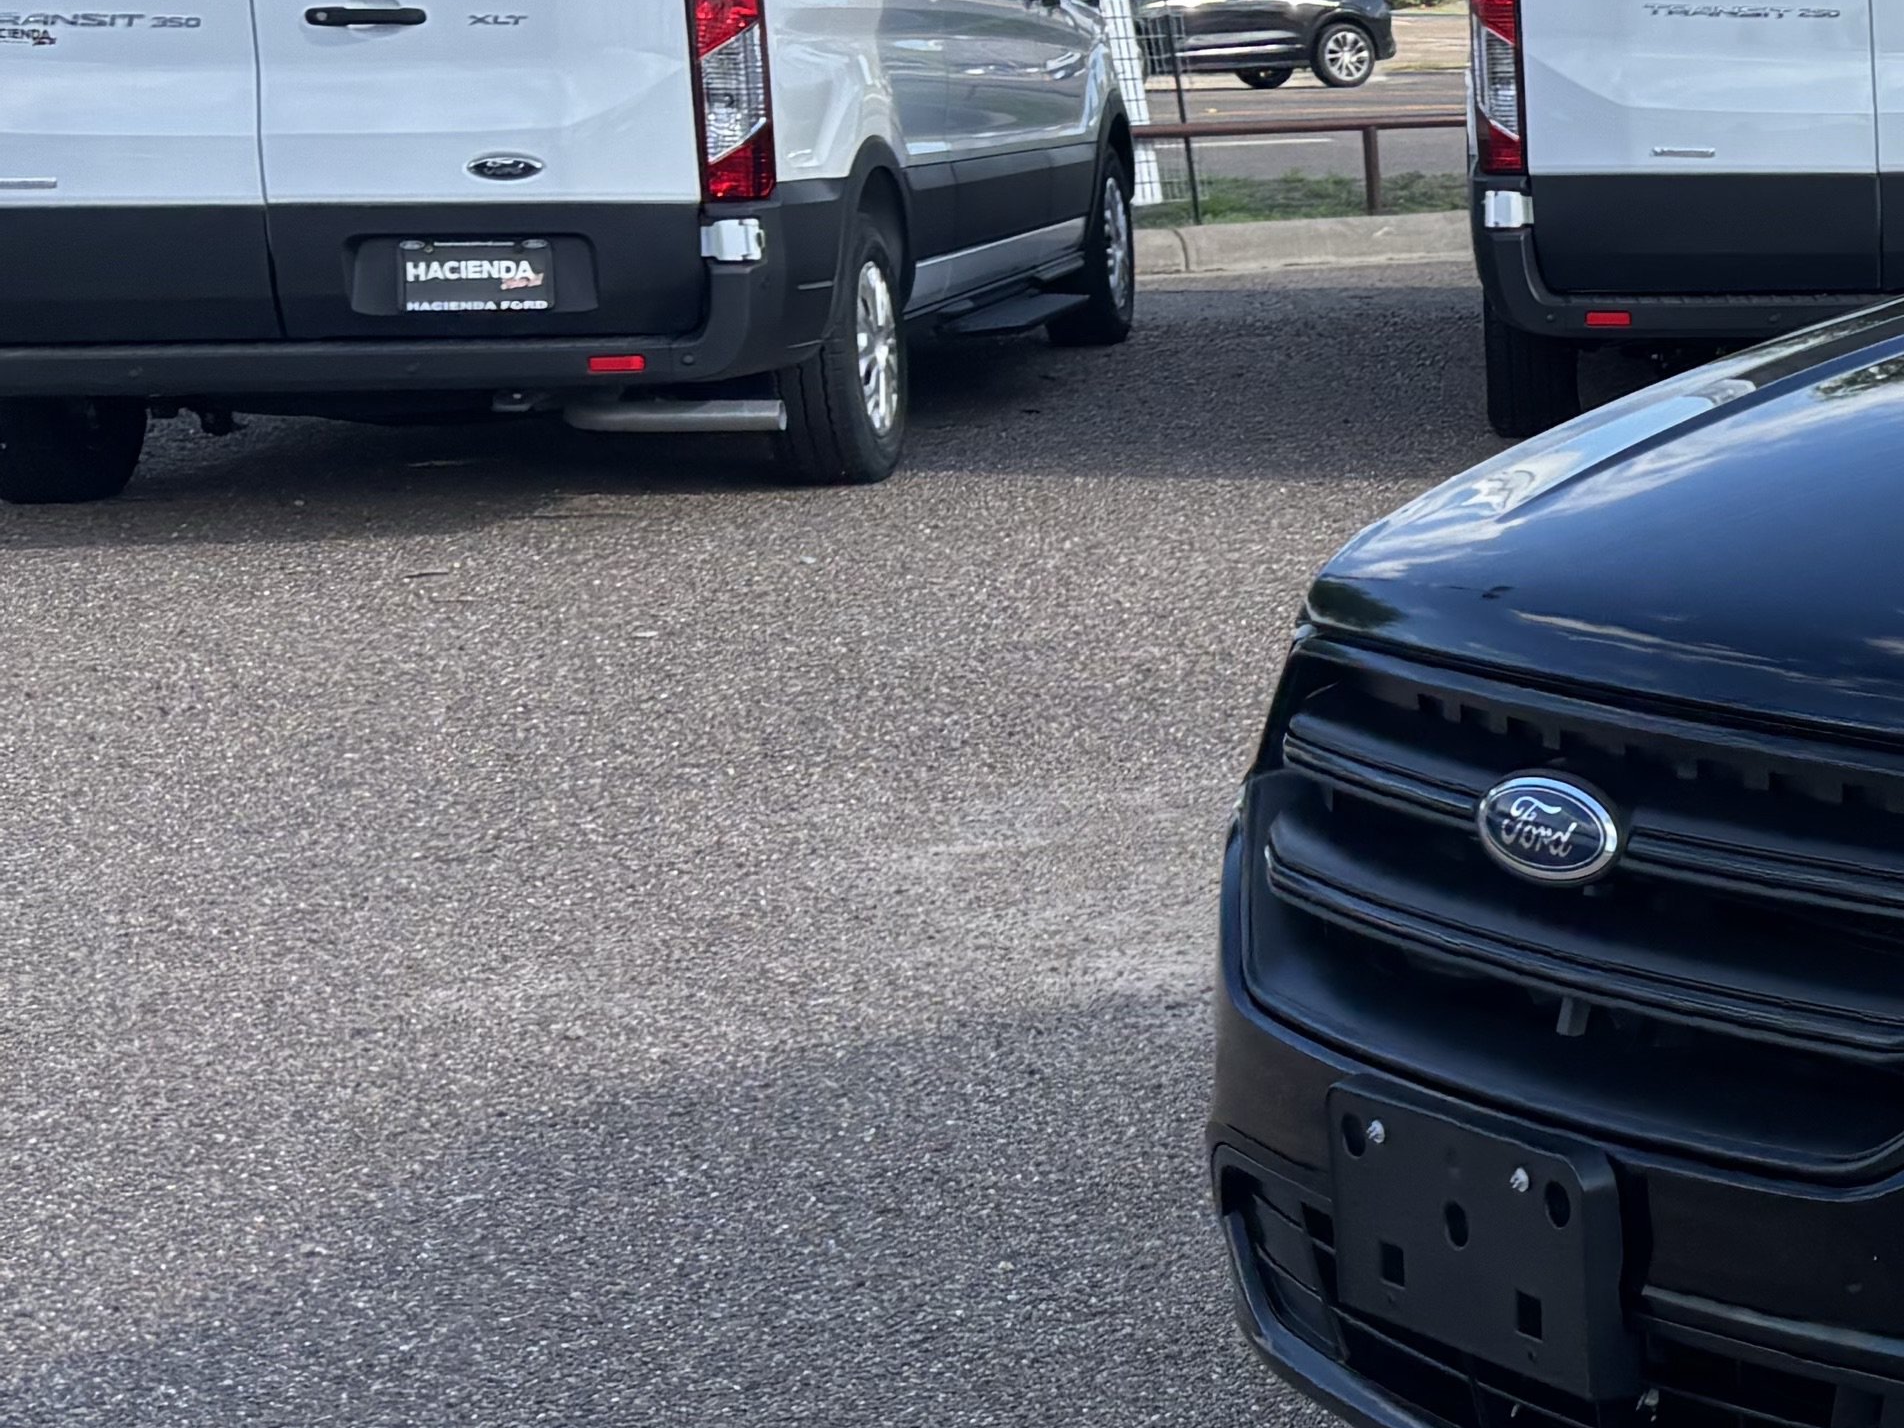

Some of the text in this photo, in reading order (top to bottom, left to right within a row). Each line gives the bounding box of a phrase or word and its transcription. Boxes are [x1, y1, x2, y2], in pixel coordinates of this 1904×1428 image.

[151, 15, 201, 28] 350
[468, 14, 528, 26] XLT
[405, 260, 536, 281] HACIENDA
[406, 300, 548, 311] HACIENDA FORD
[1501, 796, 1578, 858] Ford
